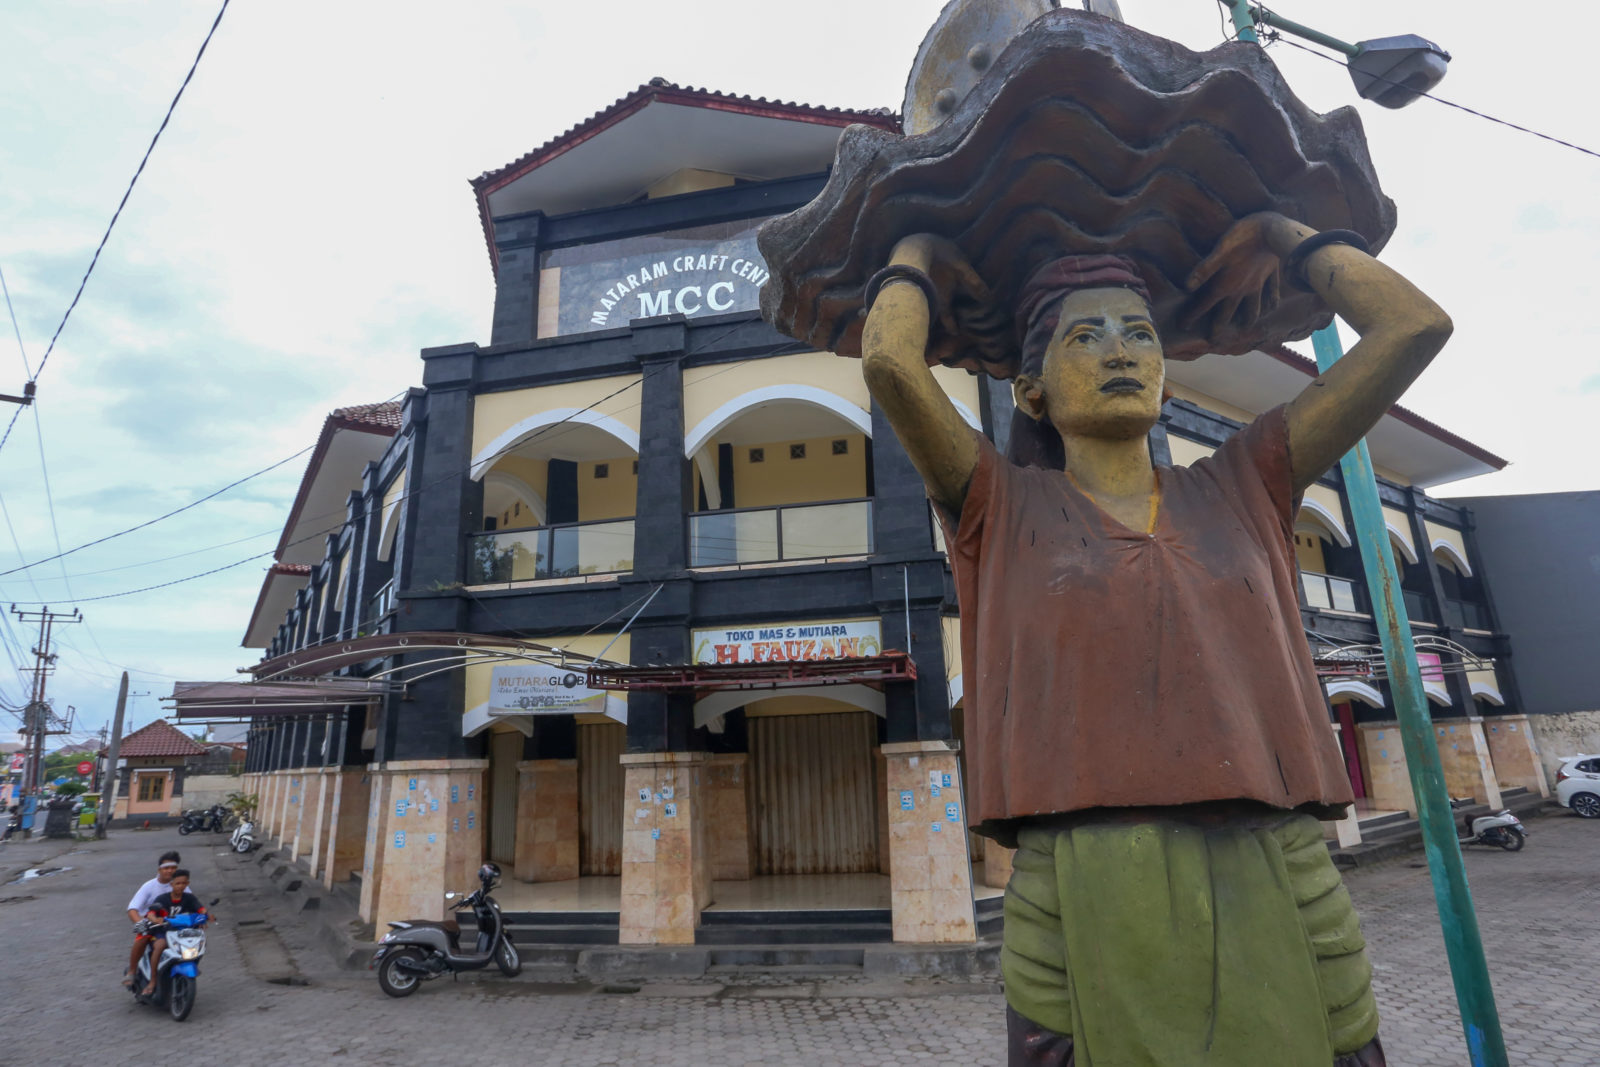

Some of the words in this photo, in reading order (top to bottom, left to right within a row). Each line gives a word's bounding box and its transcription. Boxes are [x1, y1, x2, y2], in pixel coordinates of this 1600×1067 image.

[590, 261, 668, 325] MATARAM
[673, 254, 728, 272] CRAFT
[731, 258, 770, 287] CENT
[637, 281, 735, 319] MCC
[726, 630, 754, 642] TOKO
[759, 628, 784, 640] MAS
[786, 627, 796, 638] &
[799, 625, 847, 638] MUTIARA
